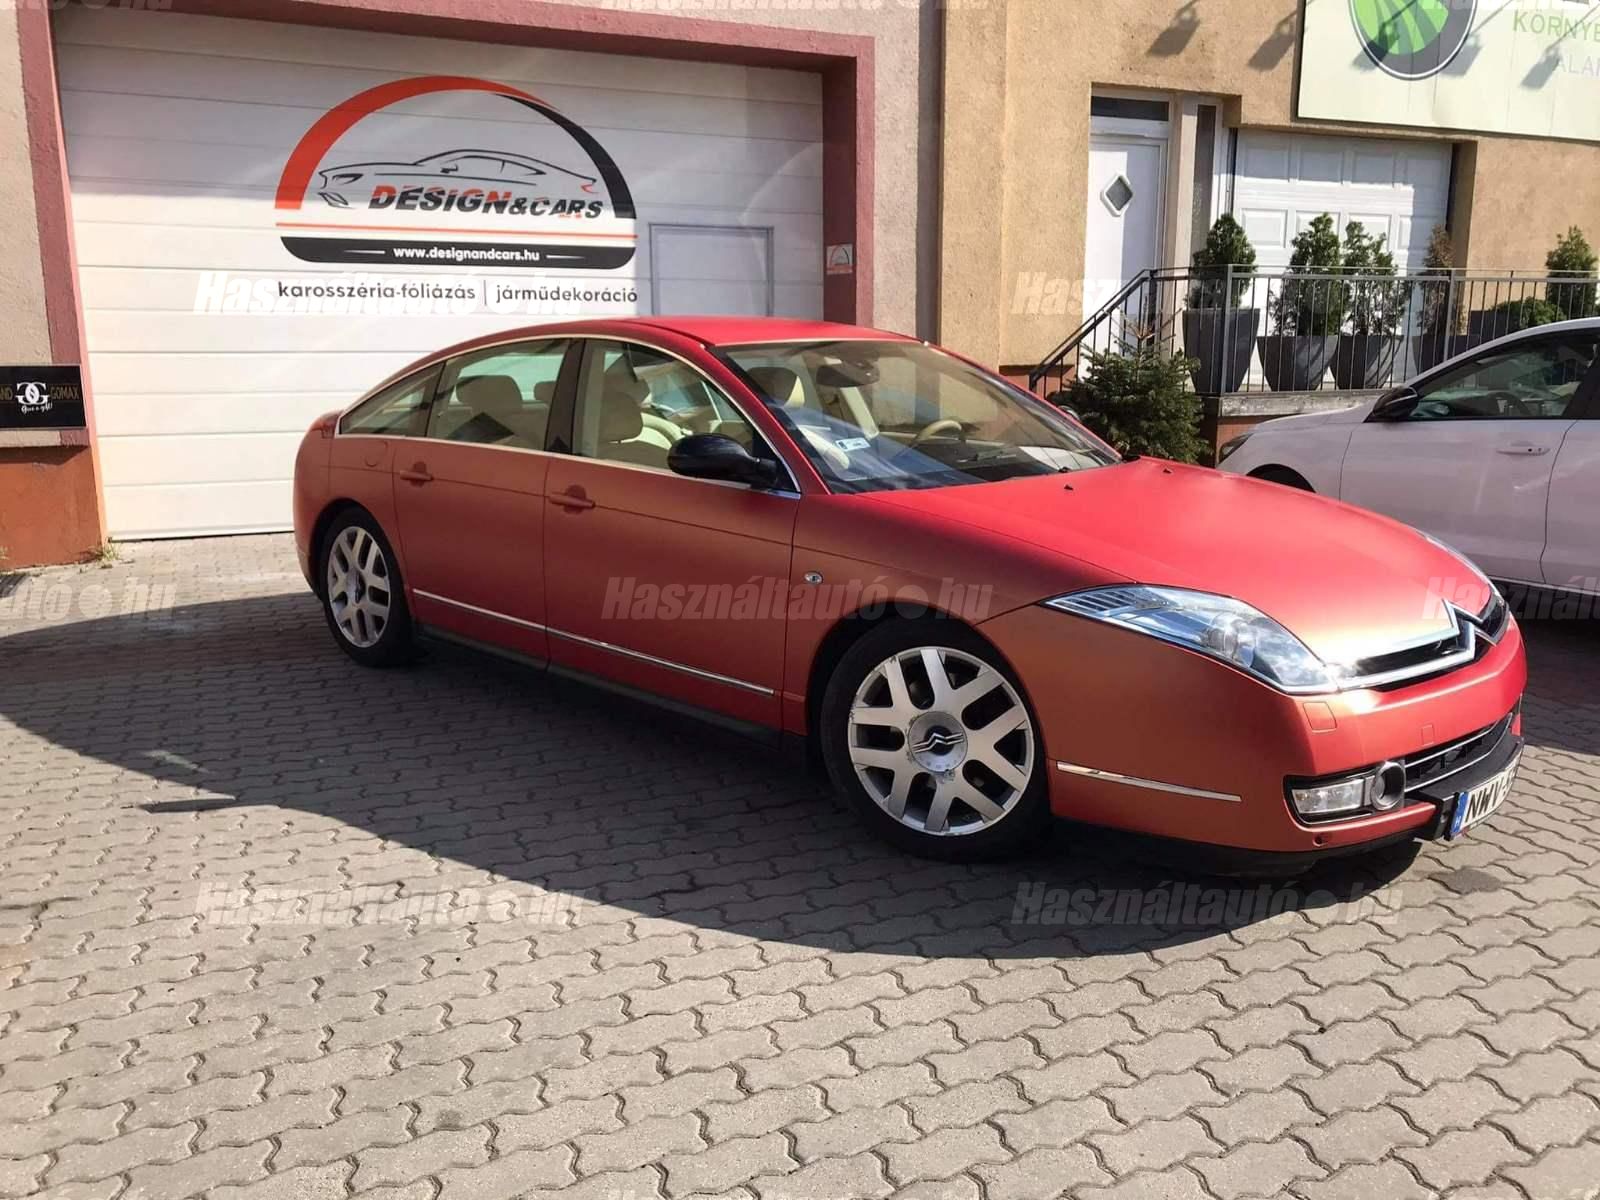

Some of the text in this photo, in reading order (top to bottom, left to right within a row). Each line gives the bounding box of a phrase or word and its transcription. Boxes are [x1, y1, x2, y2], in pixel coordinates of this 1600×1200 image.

[368, 184, 604, 219] DESIGN&CARS
[393, 247, 541, 263] www.designandcars.hu
[278, 281, 476, 301] karosszéria-fóliázás
